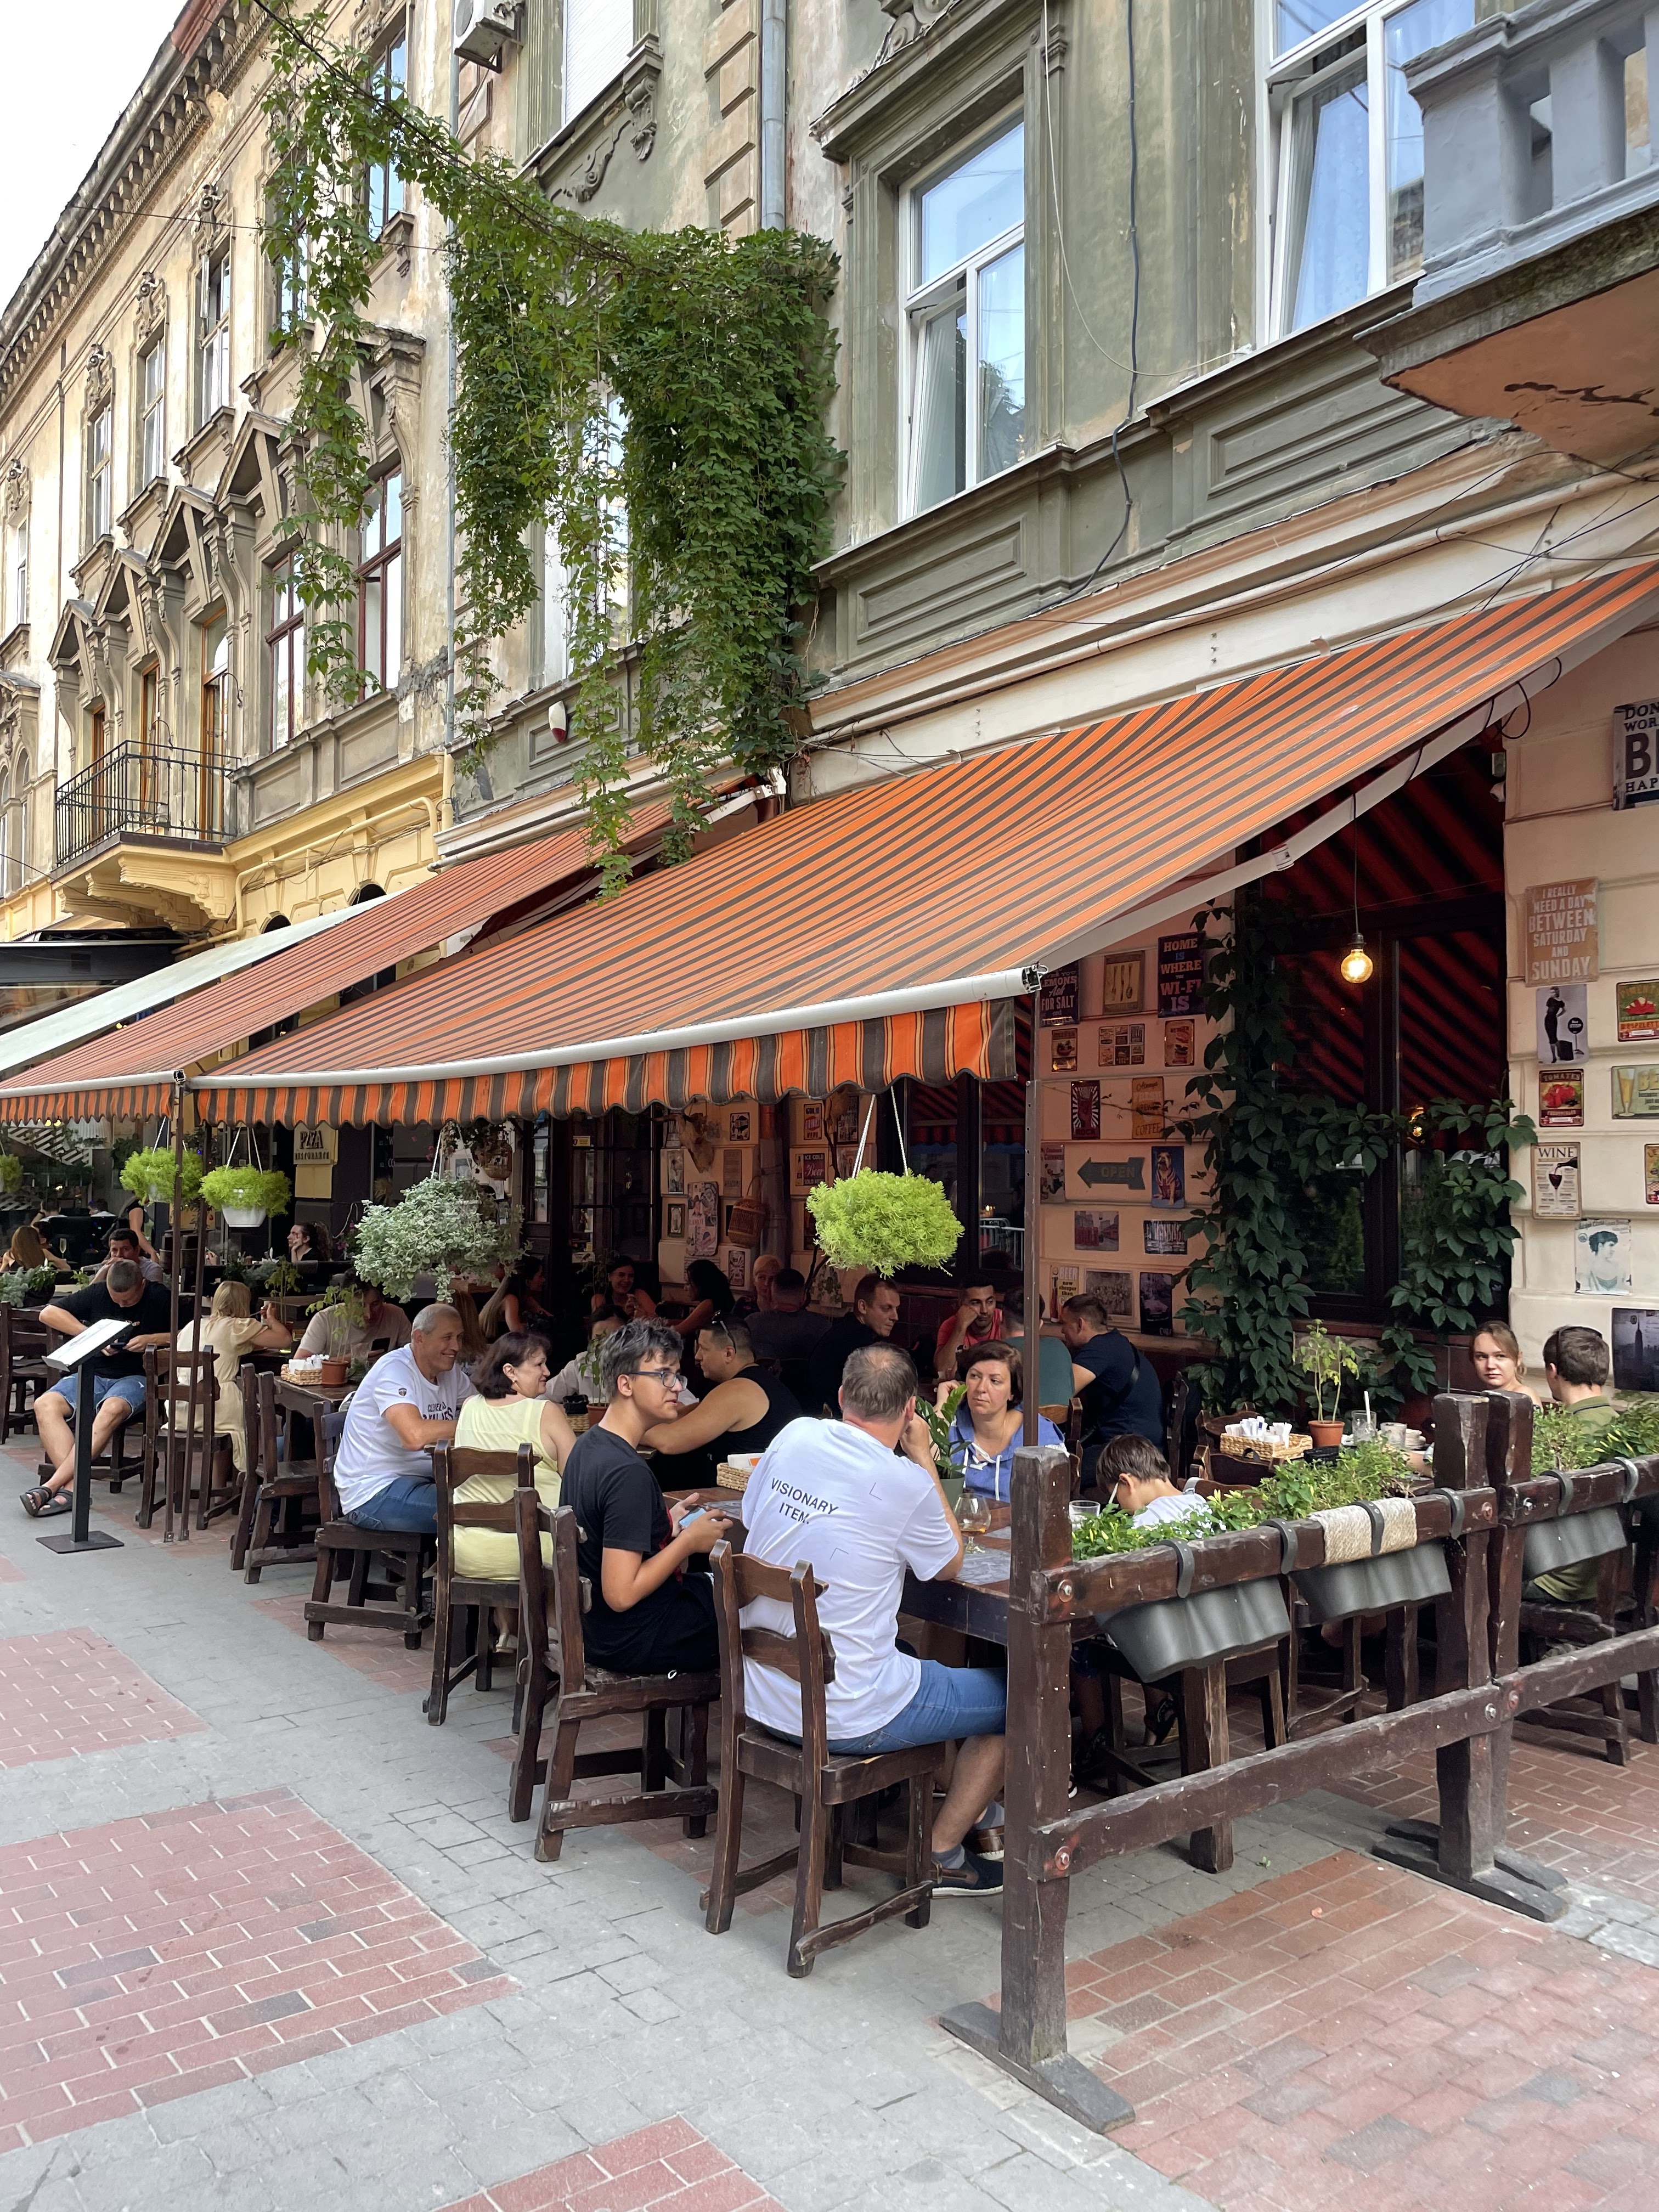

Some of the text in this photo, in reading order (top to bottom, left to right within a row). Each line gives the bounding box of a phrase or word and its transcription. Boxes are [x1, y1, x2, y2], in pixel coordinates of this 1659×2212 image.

[1626, 729, 1659, 780] B
[1543, 884, 1577, 899] I REALLY
[1533, 895, 1585, 913] NEED A DAY
[1528, 909, 1596, 933] BETWEEN
[1164, 938, 1198, 952] HOME
[1533, 928, 1587, 947] SATURDAY
[1176, 952, 1185, 960] IS
[1552, 946, 1568, 957] AND
[1160, 960, 1201, 974] WHERE
[1532, 956, 1590, 980] SUNDAY
[1042, 975, 1077, 987] LEMONS
[1160, 979, 1201, 996] WI-FI
[1042, 995, 1075, 1011] FOR SALT
[1171, 995, 1189, 1011] IS
[1136, 1122, 1161, 1136] COFFEE
[1538, 1147, 1574, 1158] WINE
[1101, 1166, 1135, 1177] OPEN
[1060, 1267, 1077, 1280] BEER
[771, 1477, 839, 1515] VISIONARY
